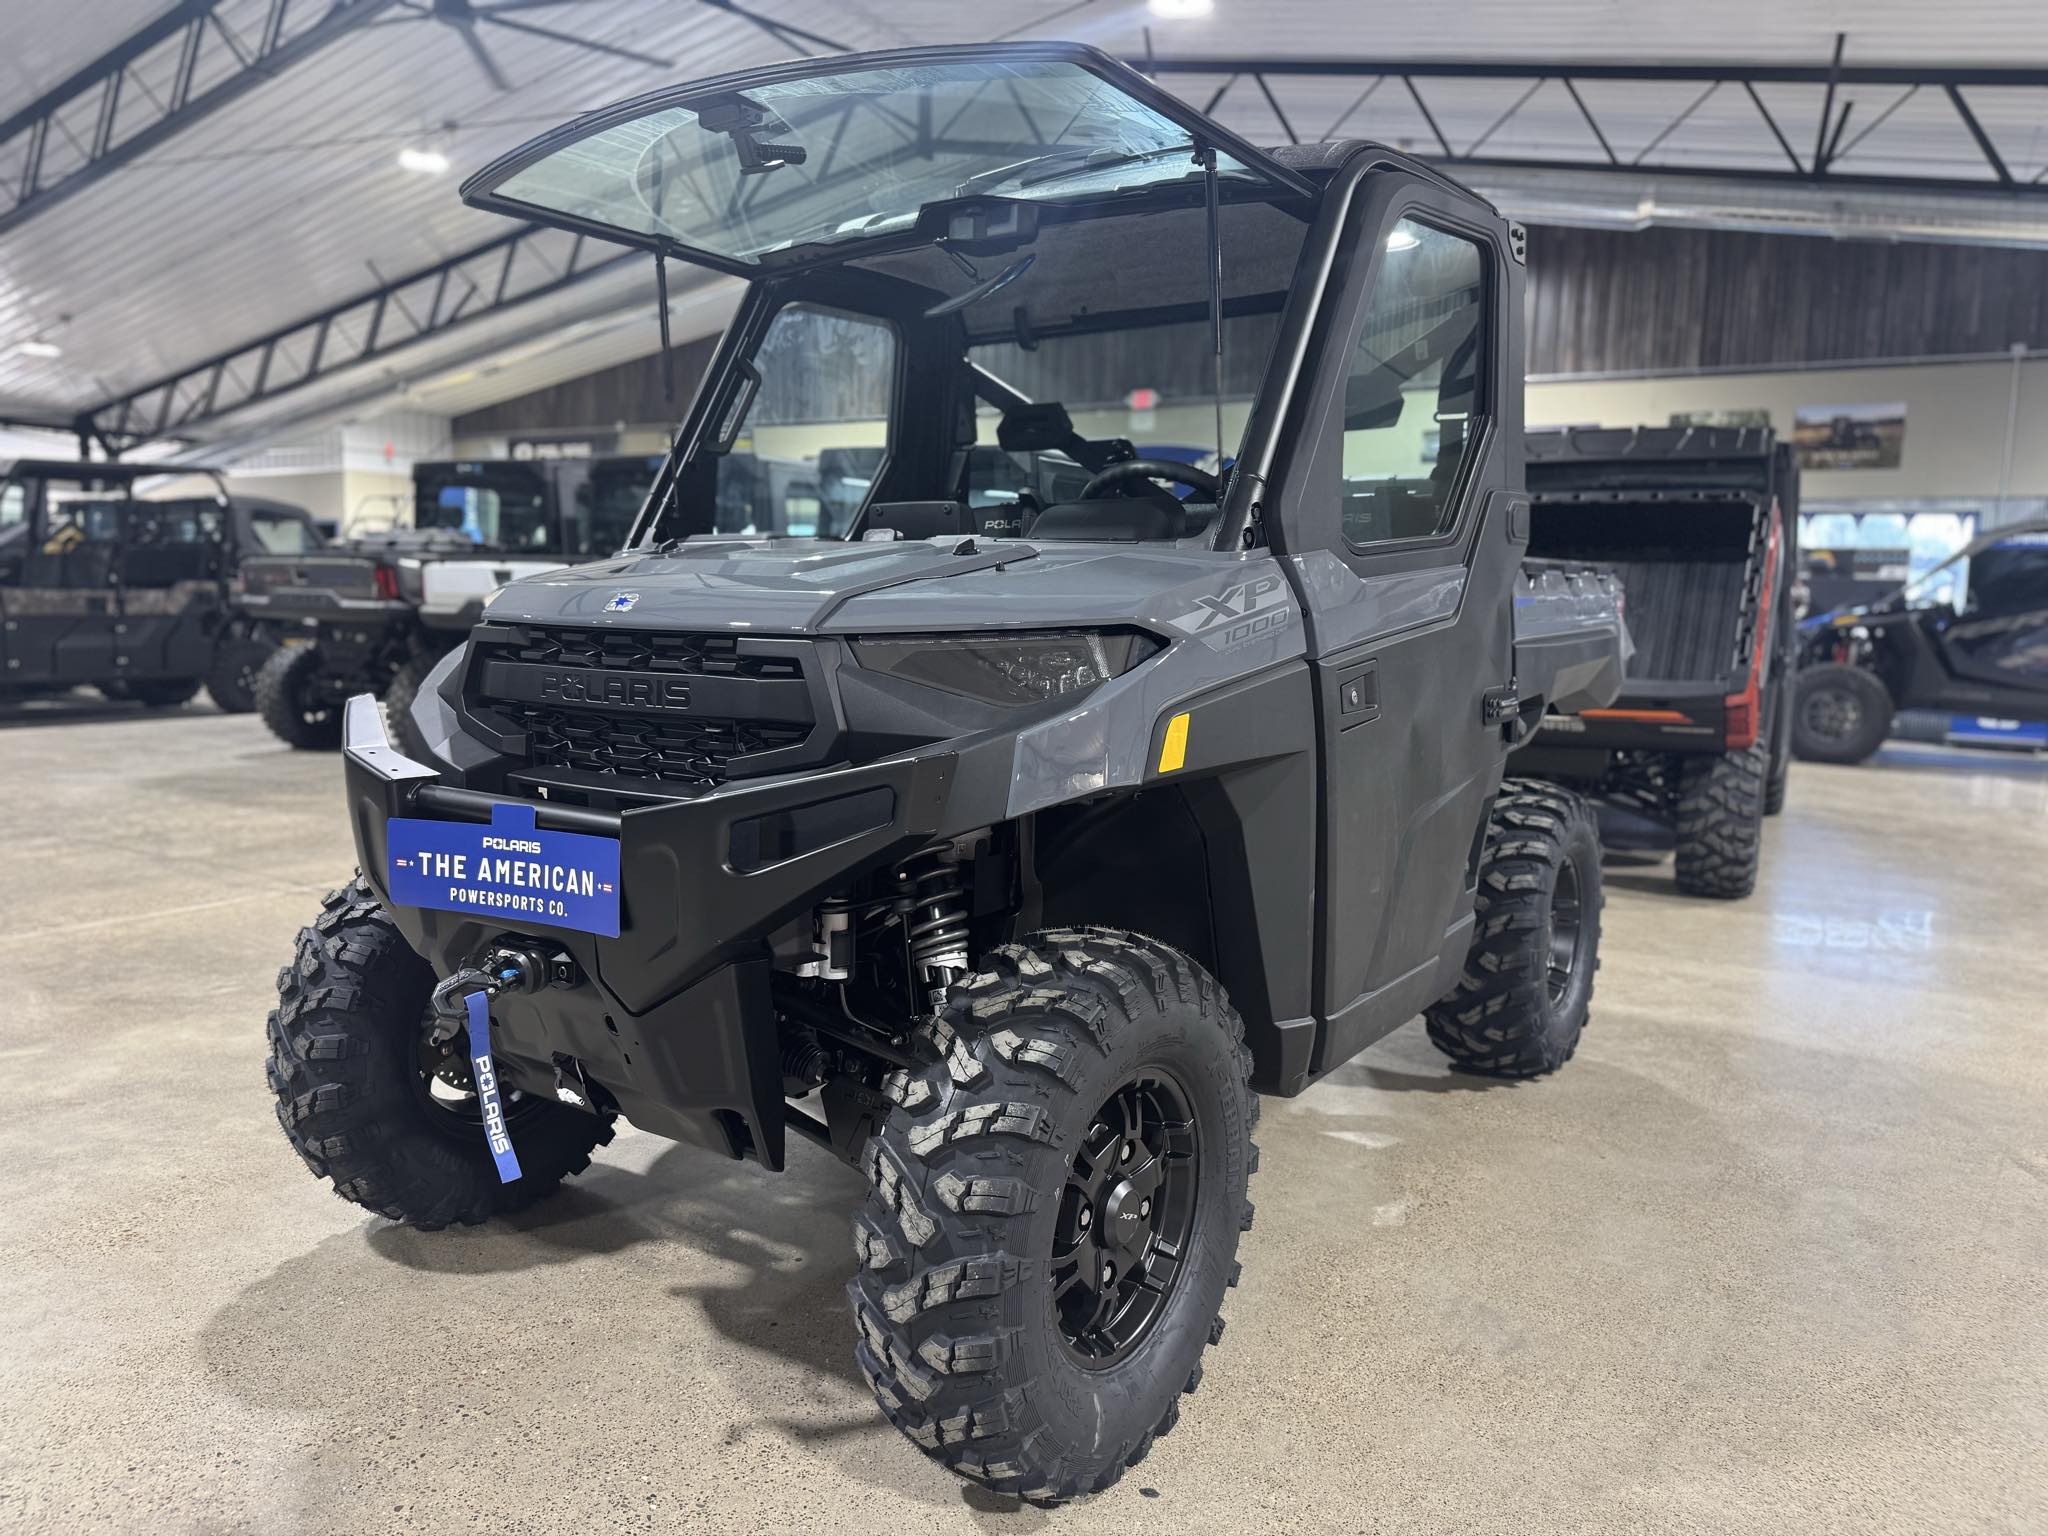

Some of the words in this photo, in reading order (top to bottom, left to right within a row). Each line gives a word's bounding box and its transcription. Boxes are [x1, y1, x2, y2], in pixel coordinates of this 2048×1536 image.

[984, 519, 1021, 530] POLA
[1191, 573, 1283, 632] XP
[1223, 608, 1288, 645] 1000
[540, 671, 692, 710] POLARIS
[482, 836, 542, 855] POLARIS
[418, 851, 467, 880] THE
[477, 856, 595, 898] AMERICAN
[450, 887, 545, 913] POWERSPORTS
[548, 900, 569, 917] CO.
[475, 1055, 510, 1154] POLARIS
